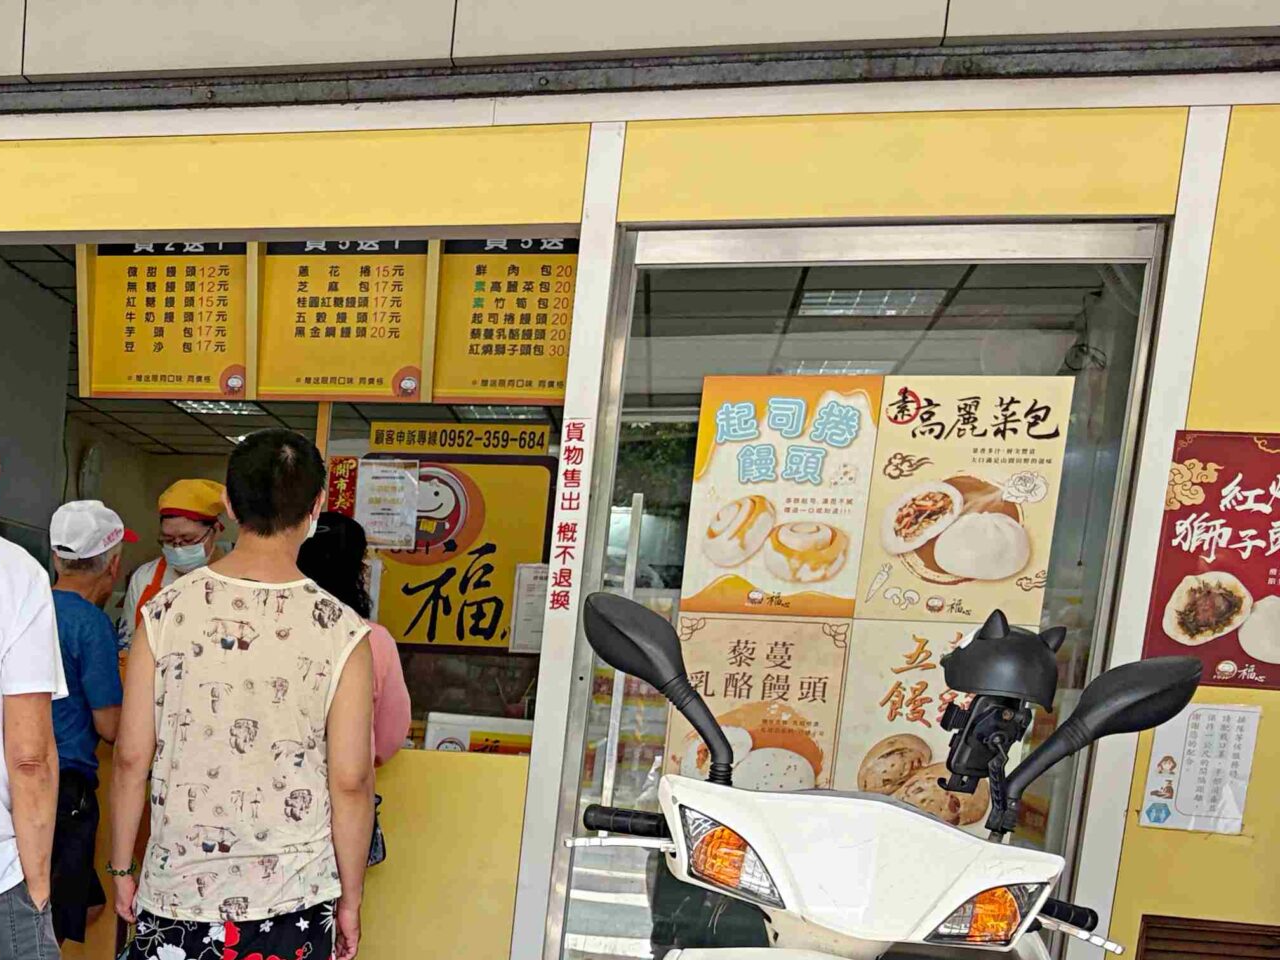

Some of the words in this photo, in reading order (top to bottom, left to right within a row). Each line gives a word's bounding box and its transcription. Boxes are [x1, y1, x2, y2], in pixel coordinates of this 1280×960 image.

[476, 264, 573, 278] 鮮肉包20
[561, 421, 586, 511] 貨物售出
[736, 444, 826, 484] 饅頭
[1219, 472, 1280, 514] 紅
[402, 540, 512, 642] 福
[690, 670, 829, 703] 乳酪饅頭
